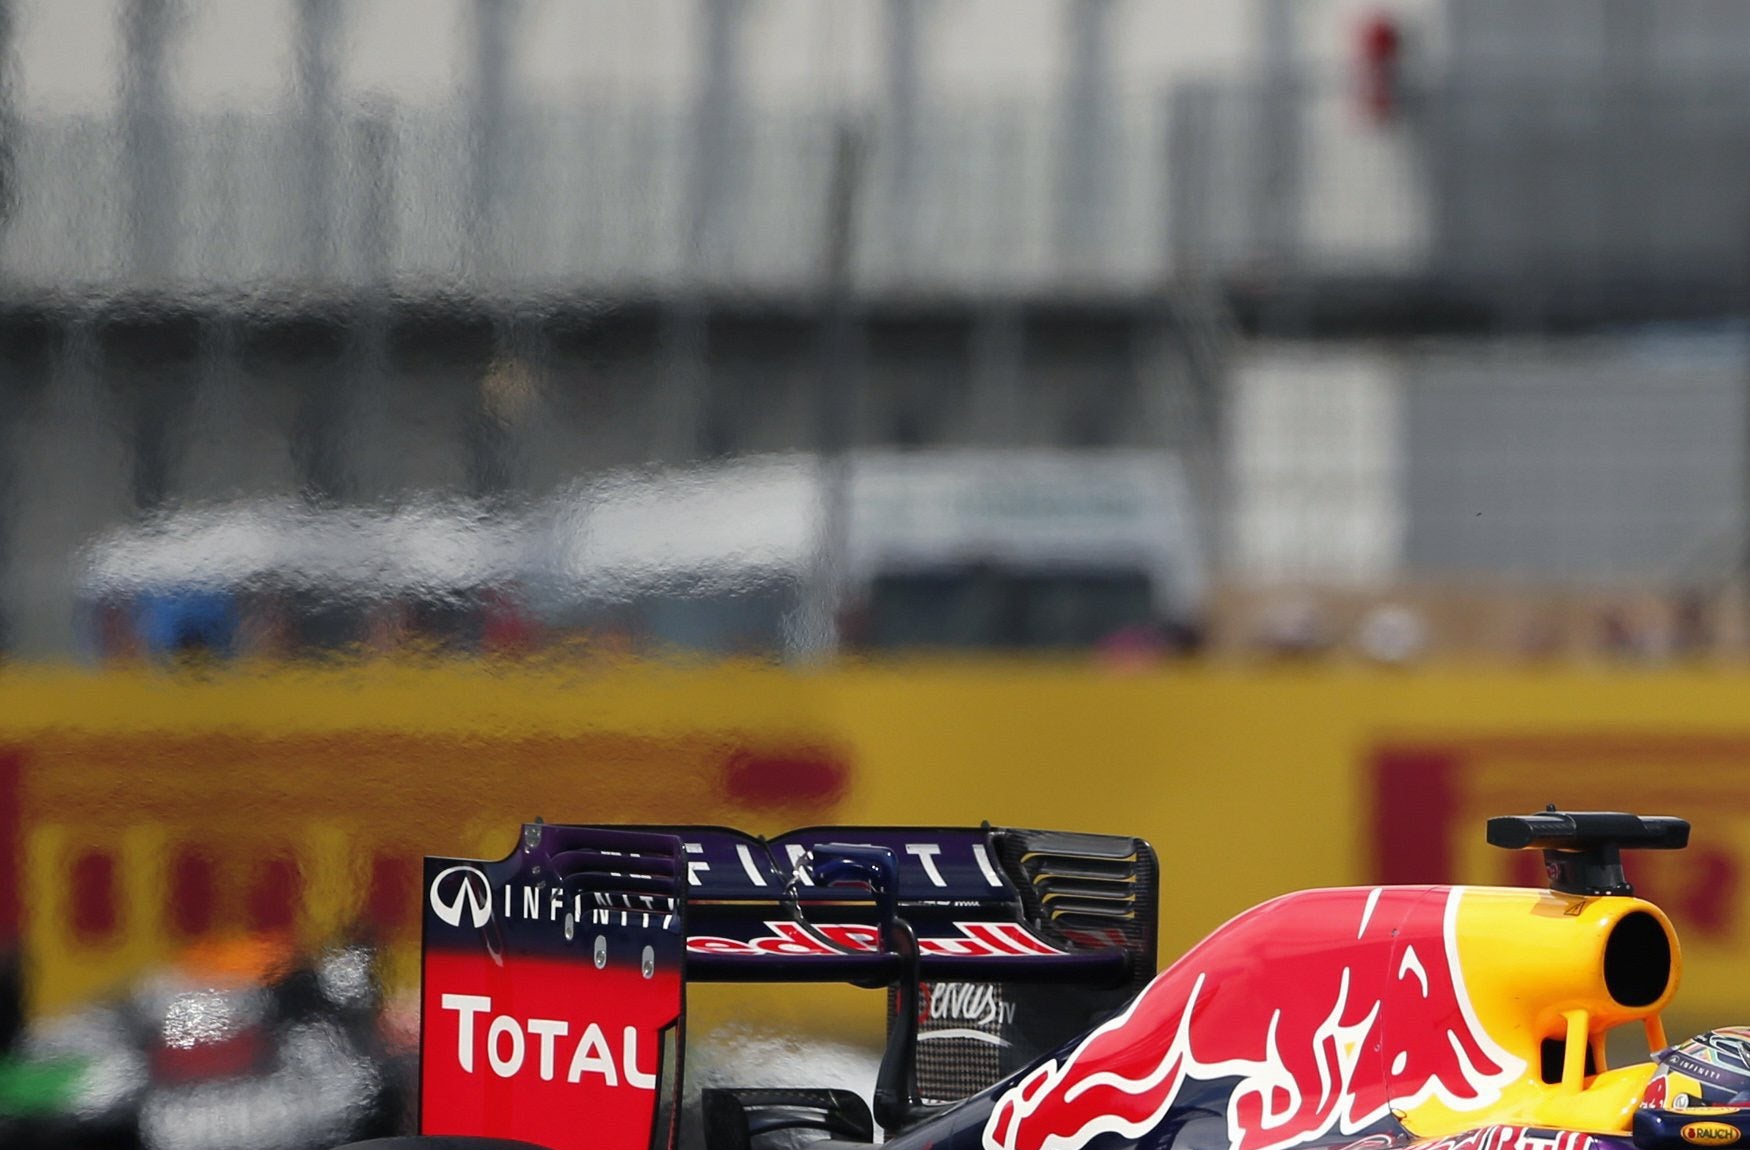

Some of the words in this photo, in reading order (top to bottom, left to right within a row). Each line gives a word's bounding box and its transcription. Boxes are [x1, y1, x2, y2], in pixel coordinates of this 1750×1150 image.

[442, 993, 657, 1090] TOTAL
[1679, 1060, 1721, 1080] INFINITI
[1697, 1128, 1733, 1139] RAUCH
